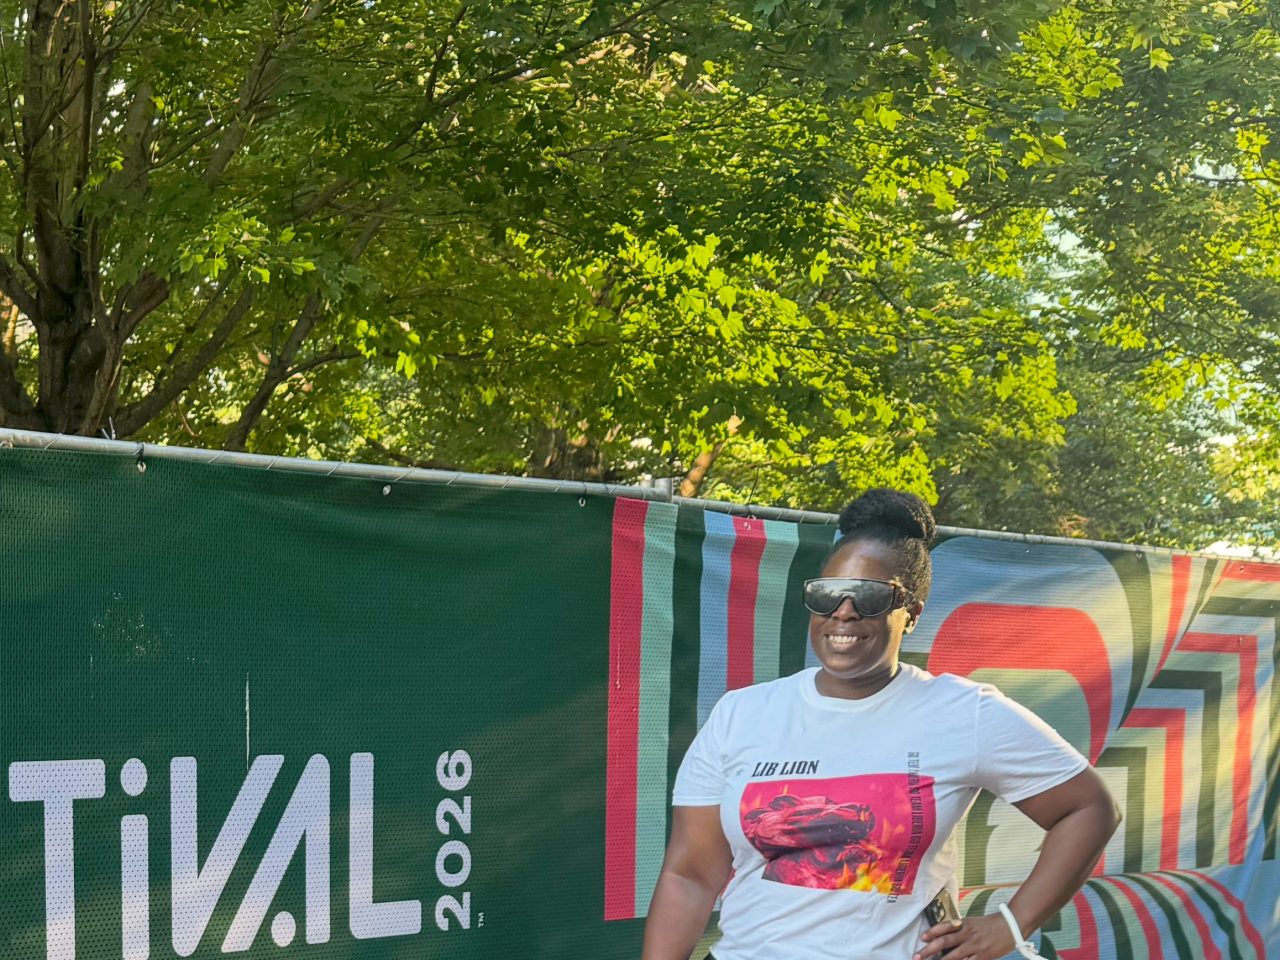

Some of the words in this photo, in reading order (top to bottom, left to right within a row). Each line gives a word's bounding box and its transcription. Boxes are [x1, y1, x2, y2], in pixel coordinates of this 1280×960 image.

[751, 761, 779, 777] LIB
[779, 760, 820, 776] LION
[435, 749, 473, 931] 2026
